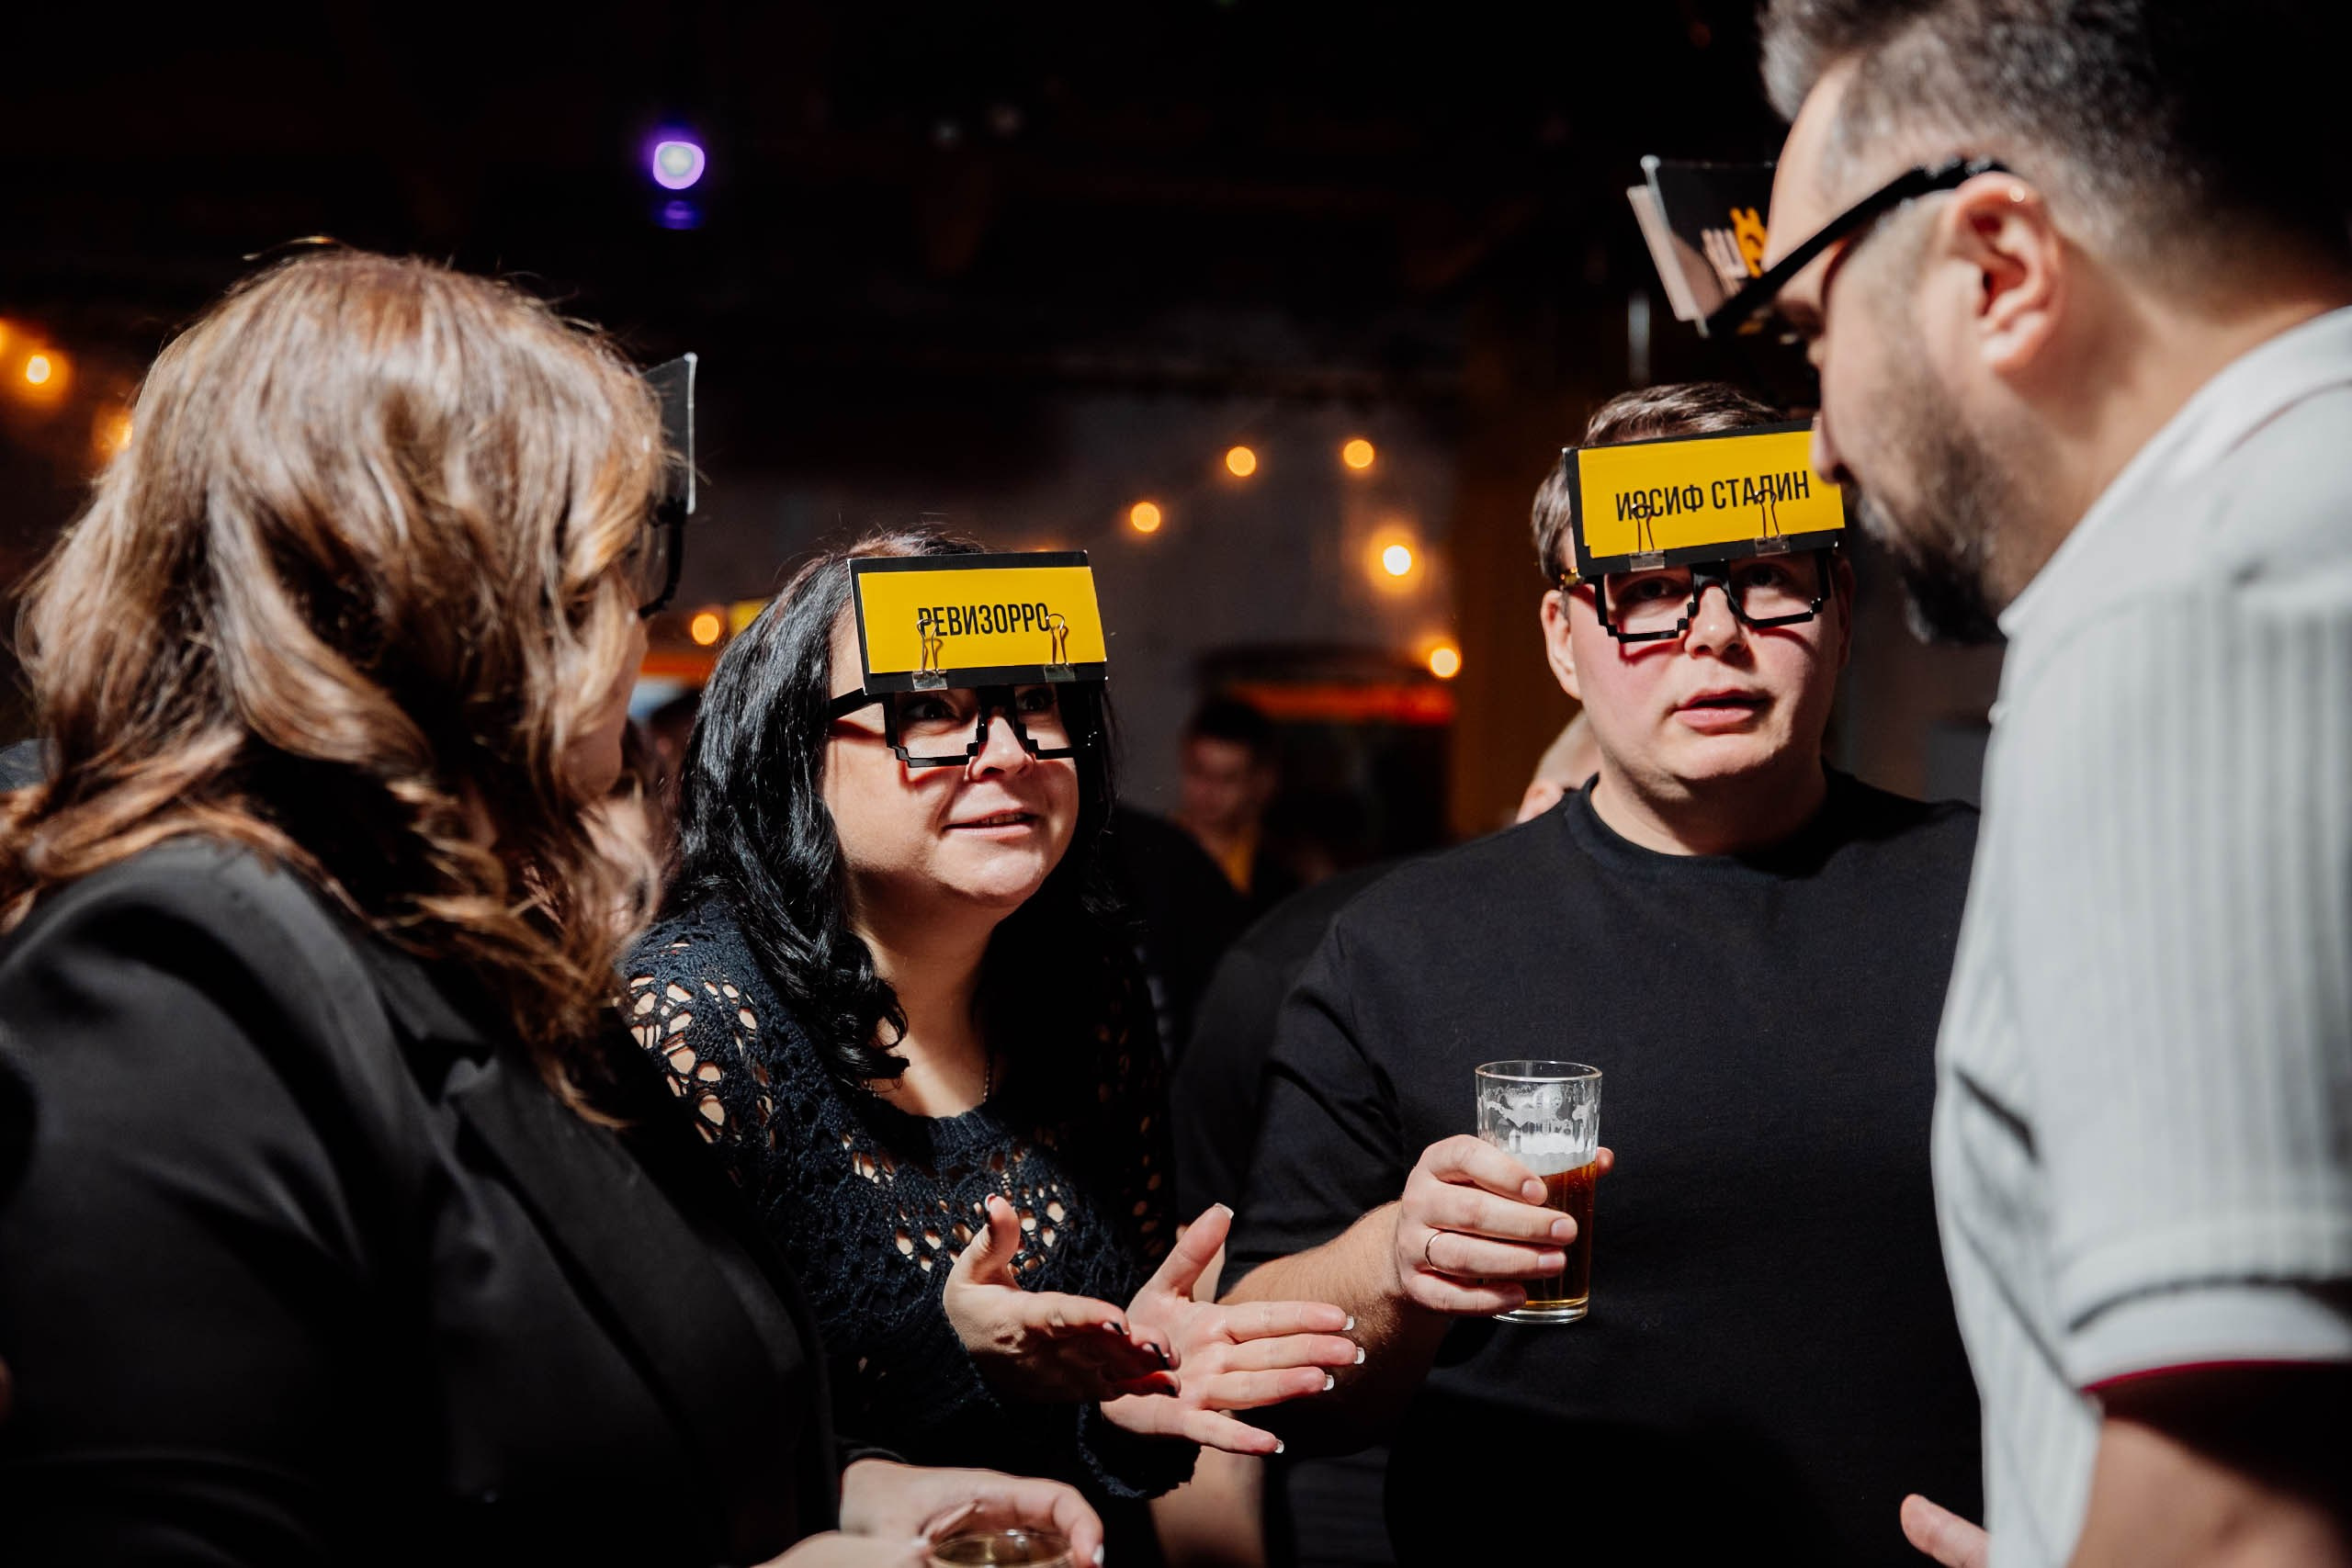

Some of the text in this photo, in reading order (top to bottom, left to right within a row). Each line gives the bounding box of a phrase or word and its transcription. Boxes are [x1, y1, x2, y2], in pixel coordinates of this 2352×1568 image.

[1615, 469, 1810, 522] ИОСИФ СТАЛИН
[917, 603, 1051, 637] РЕВИЗОРРО
